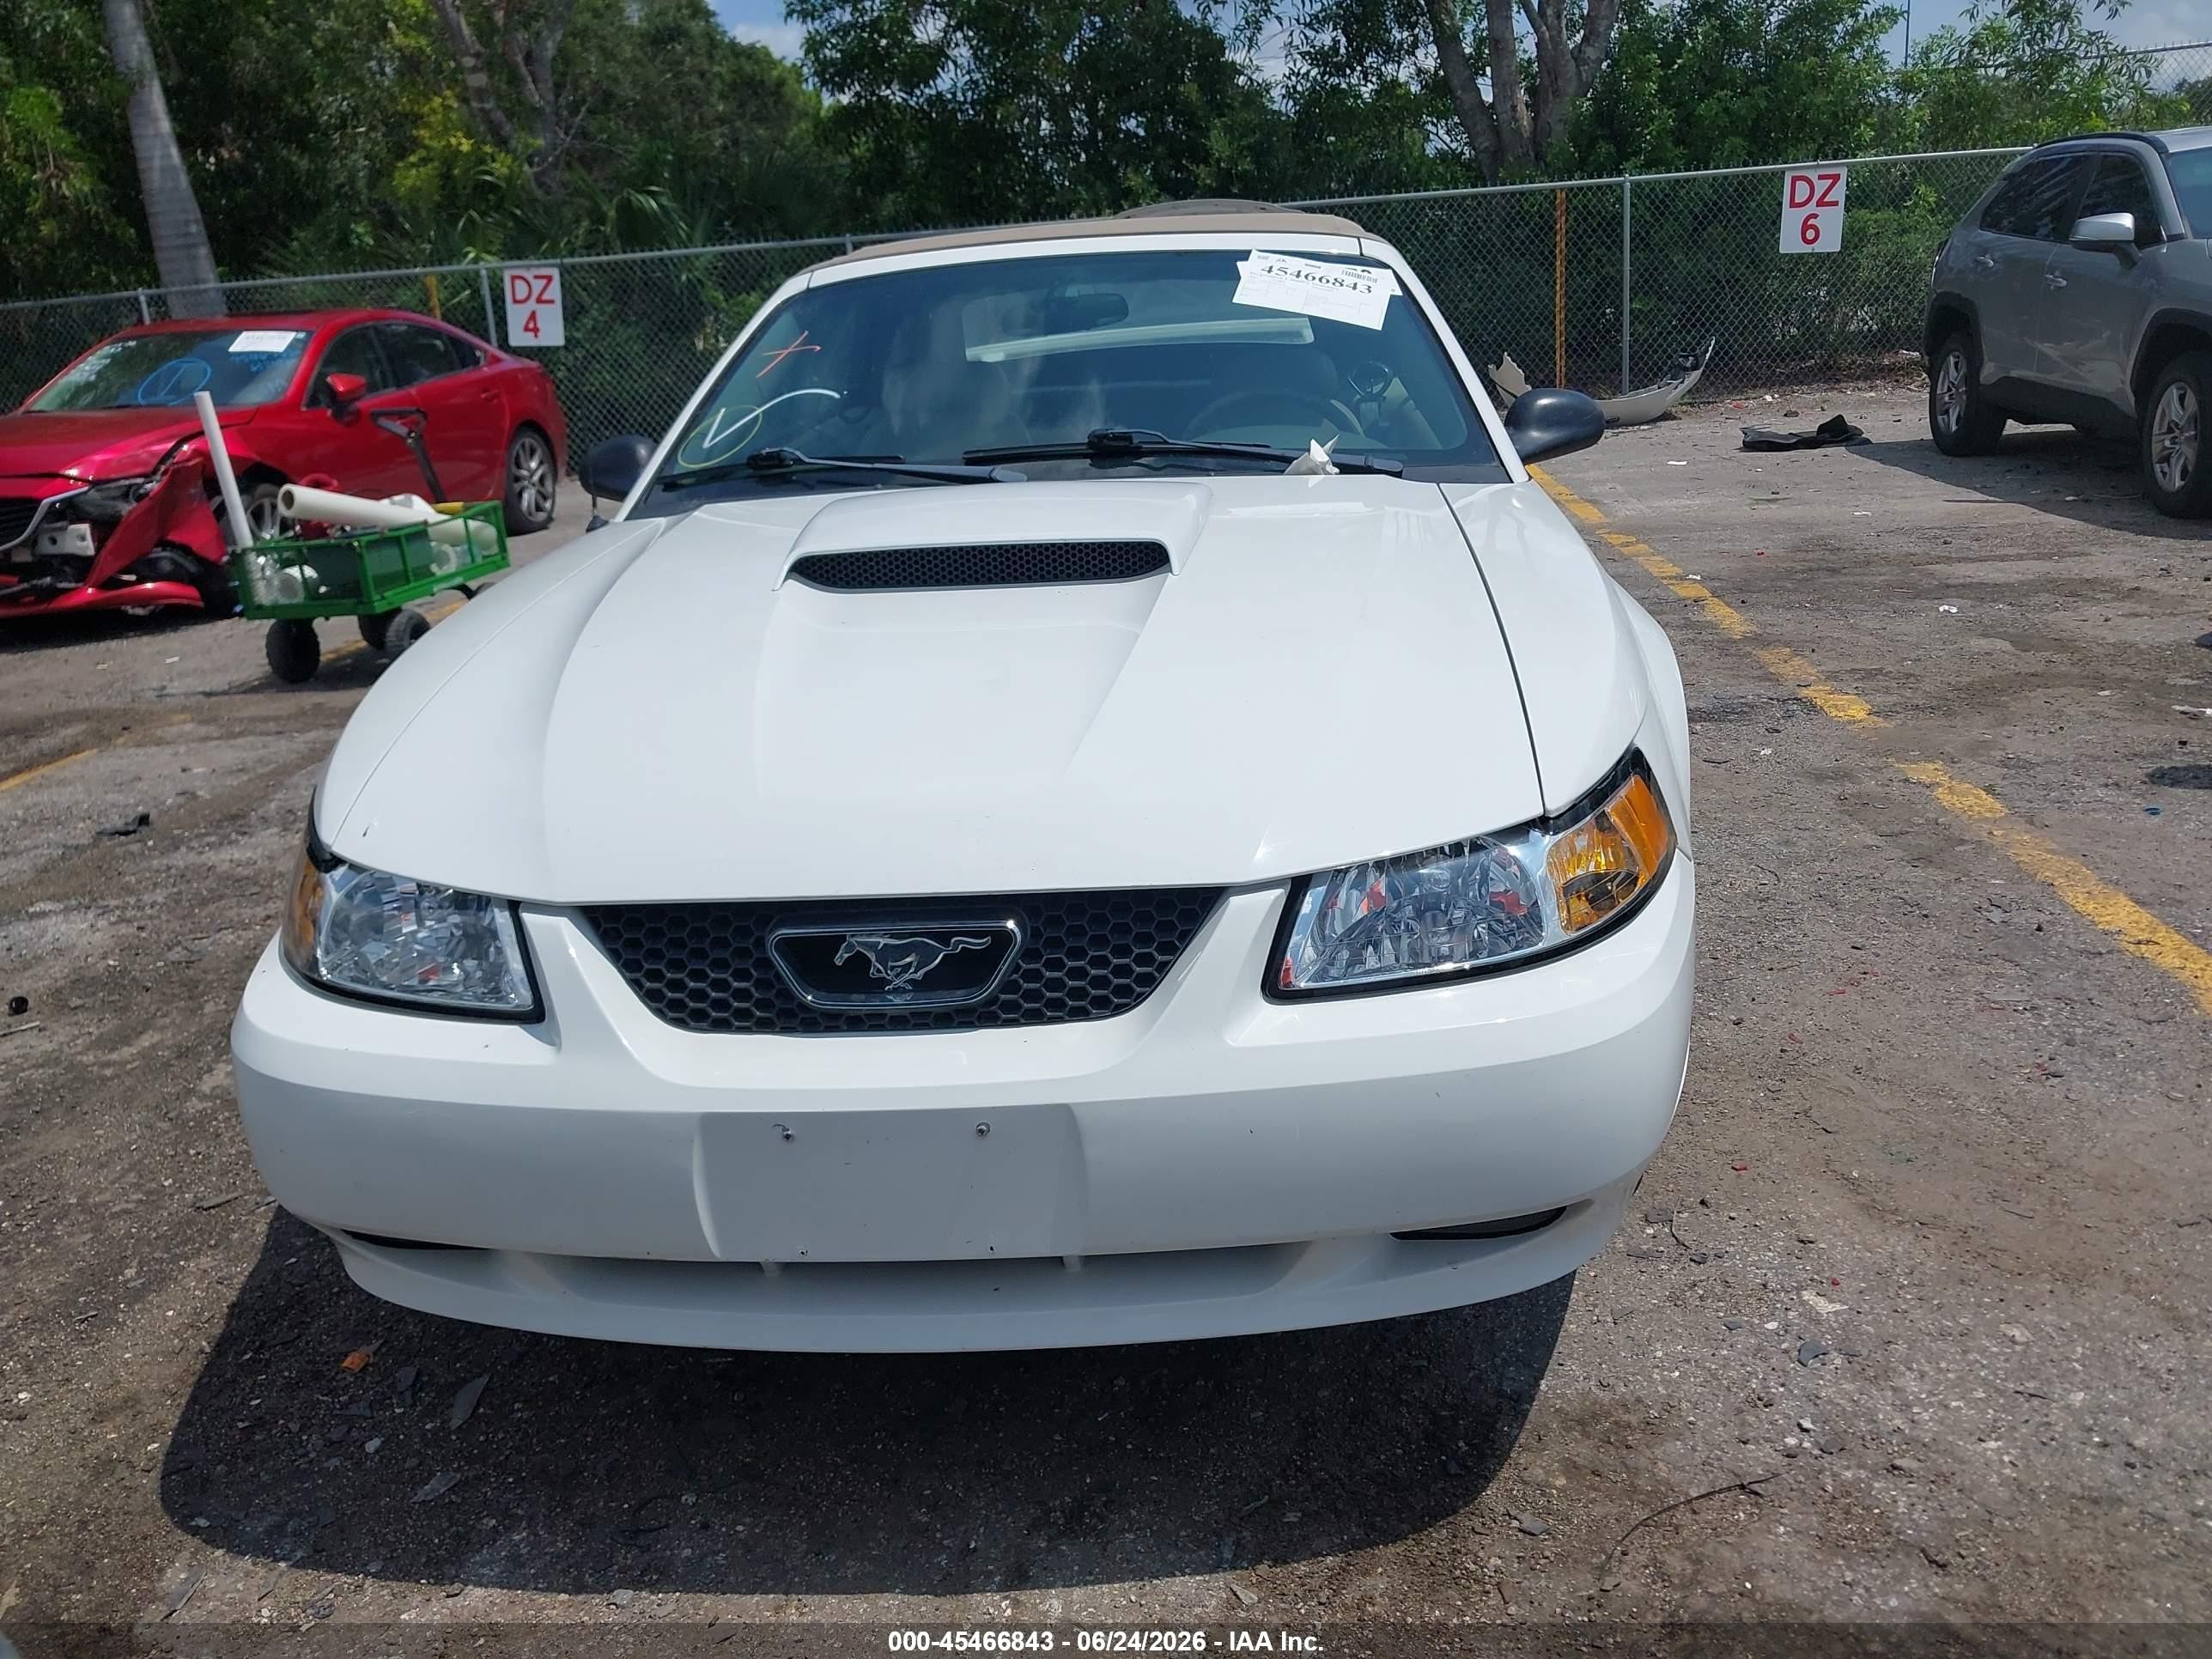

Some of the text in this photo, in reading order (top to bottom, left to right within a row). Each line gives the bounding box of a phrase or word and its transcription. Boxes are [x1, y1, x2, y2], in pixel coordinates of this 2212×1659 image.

[1789, 173, 1841, 209] DZ
[1801, 213, 1820, 246] 6
[510, 275, 555, 304] DZ
[1260, 264, 1372, 295] 45466843
[522, 309, 540, 339] 4
